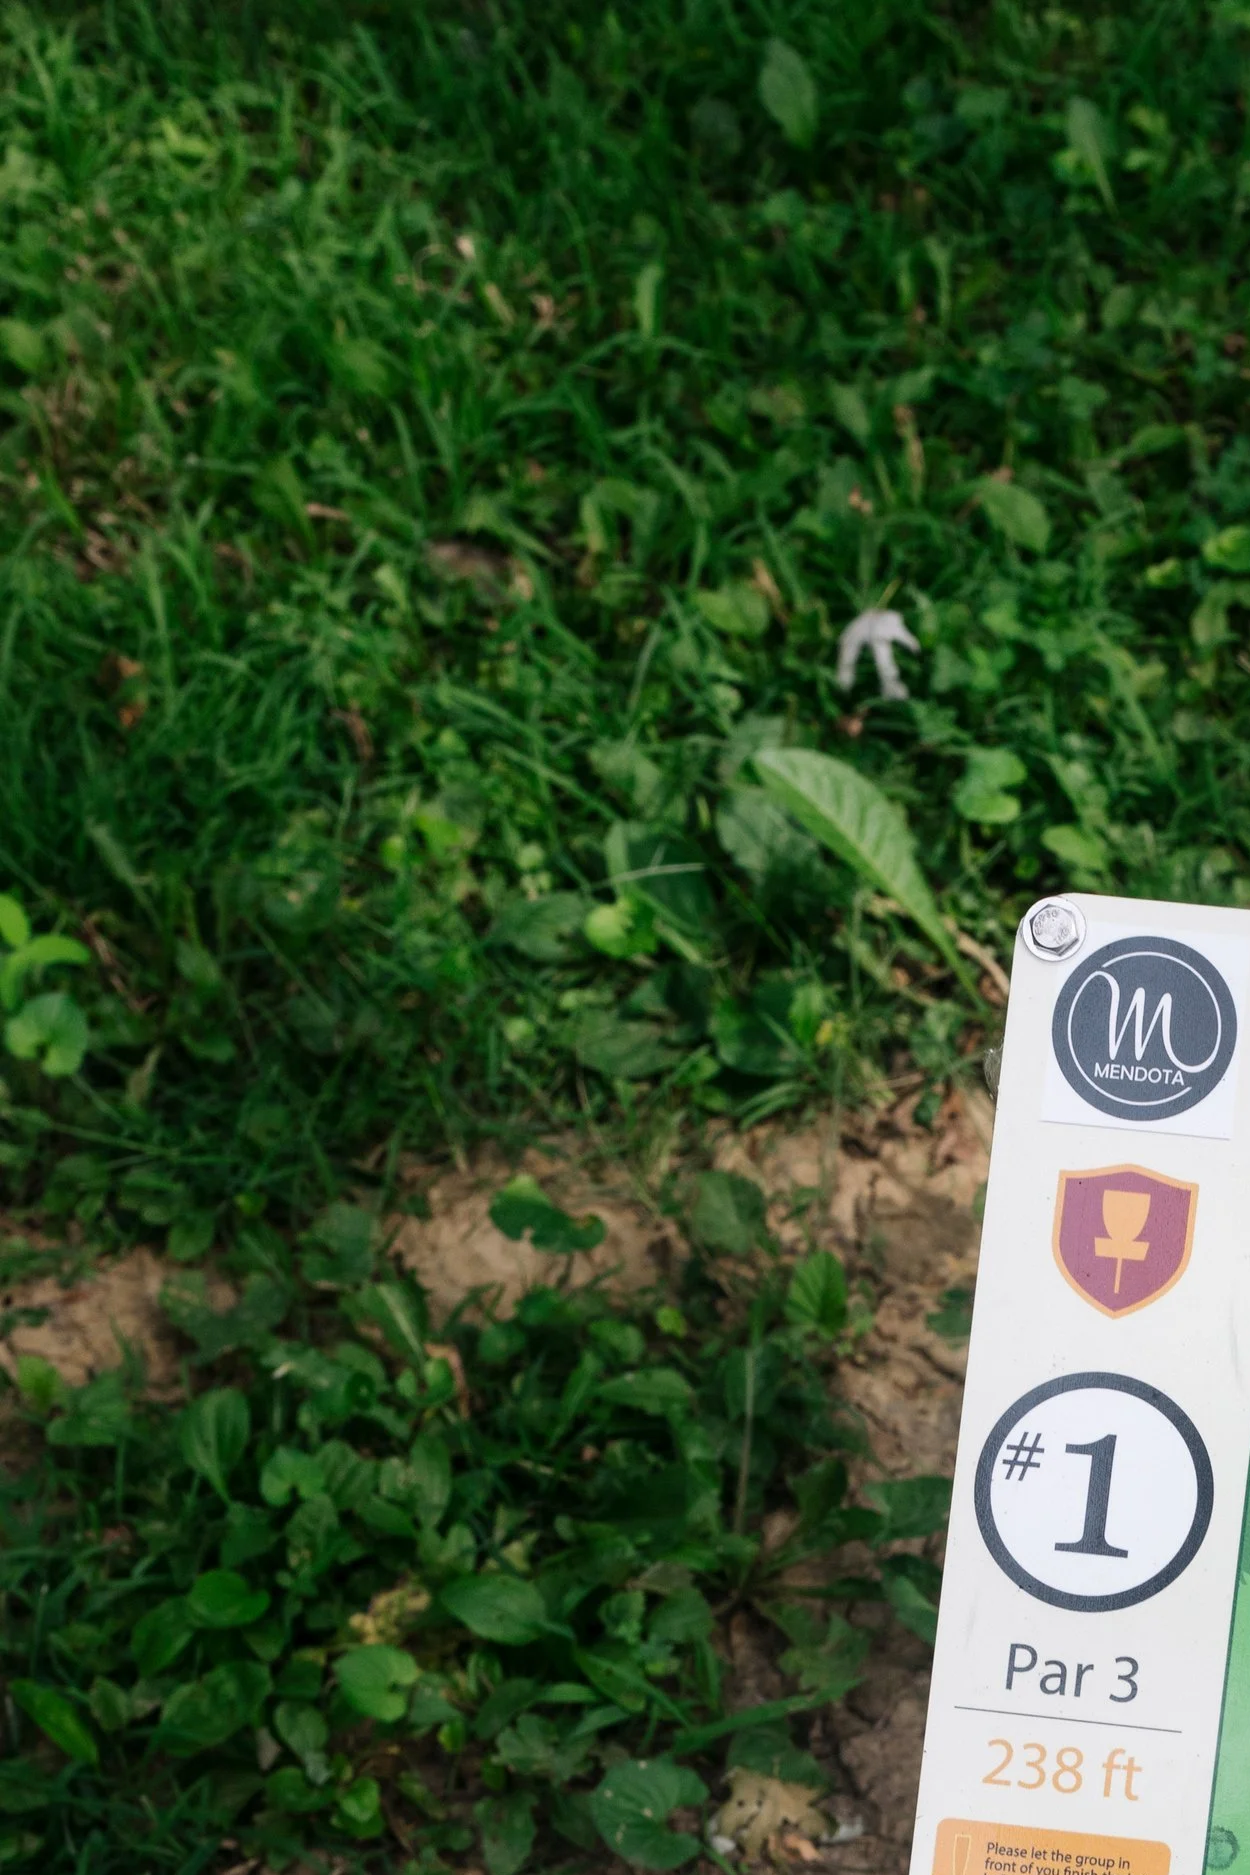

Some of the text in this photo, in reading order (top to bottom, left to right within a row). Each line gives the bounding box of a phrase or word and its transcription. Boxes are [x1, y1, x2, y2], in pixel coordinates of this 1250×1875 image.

[1094, 1062, 1185, 1086] MENDOTA
[1005, 1642, 1140, 1703] Par 3
[982, 1738, 1143, 1802] 238 ft
[984, 1857, 1016, 1873] front
[1020, 1863, 1034, 1874] of
[986, 1842, 1130, 1870] Please let the group in
